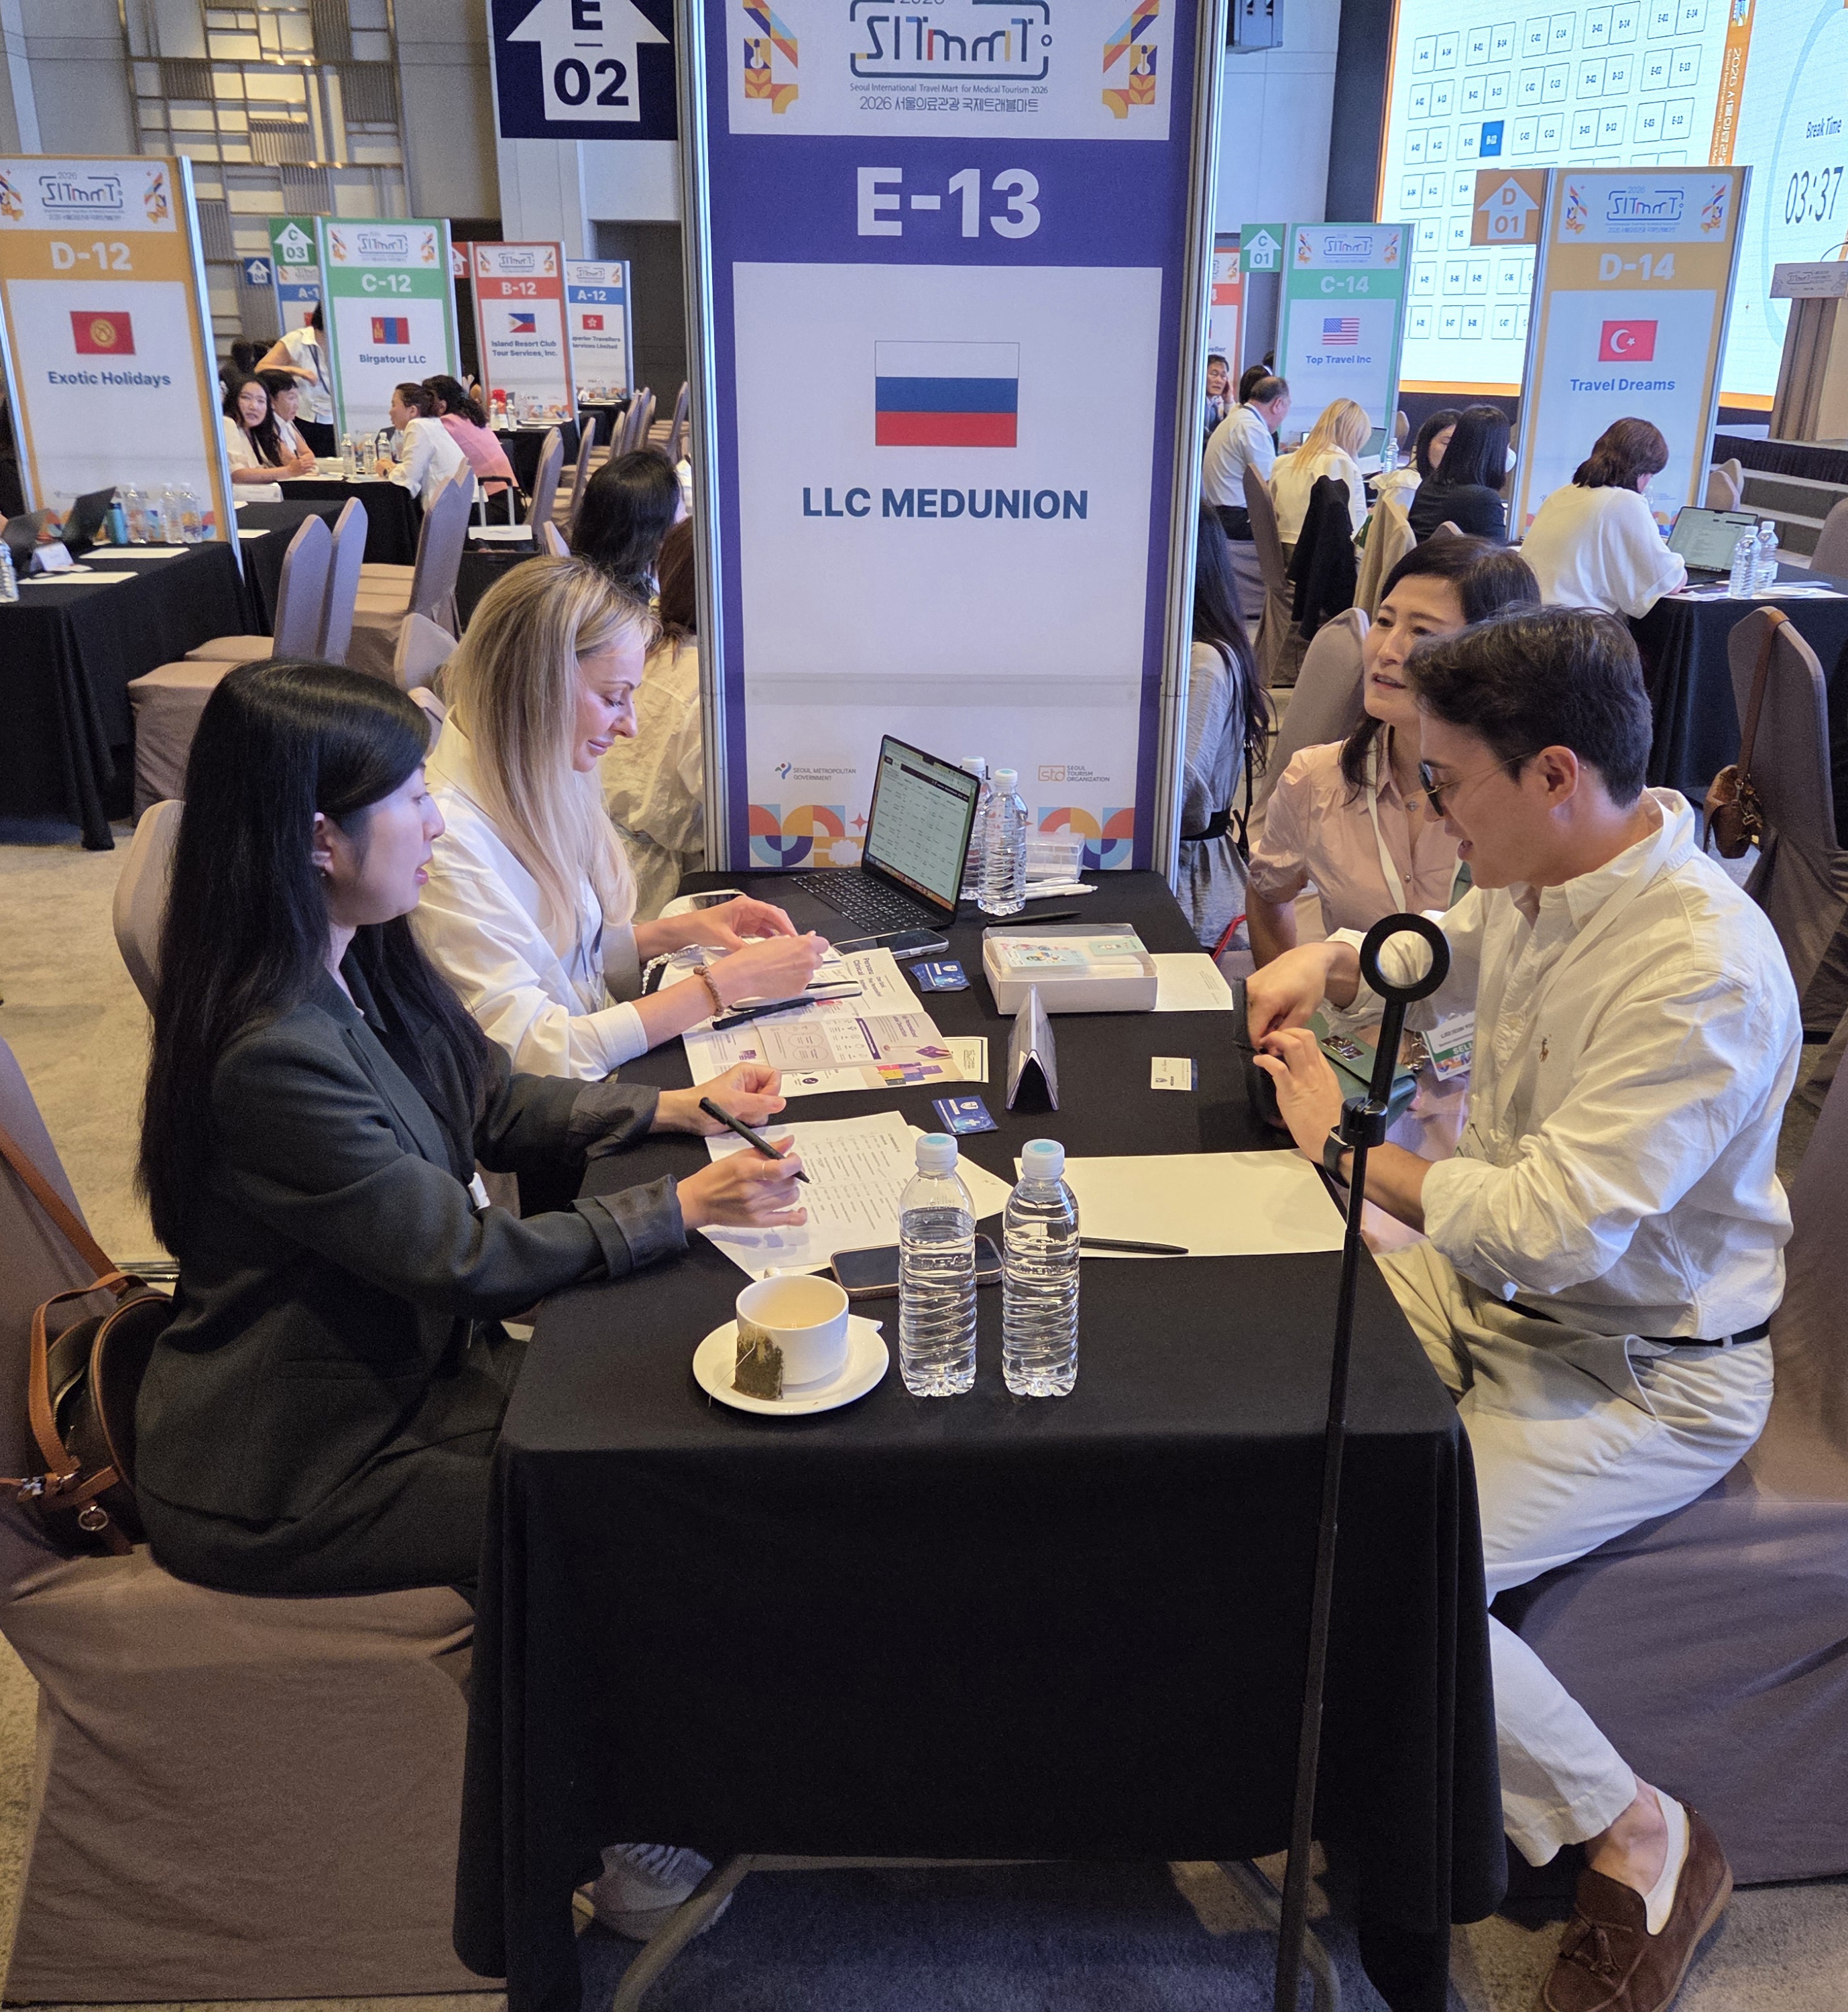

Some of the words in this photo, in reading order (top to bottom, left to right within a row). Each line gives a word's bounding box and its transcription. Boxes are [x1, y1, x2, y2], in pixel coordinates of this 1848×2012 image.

[571, 0, 602, 30] E
[554, 58, 628, 106] 02
[850, 83, 870, 91] Seoul
[872, 83, 916, 91] International
[919, 84, 939, 92] Travel
[962, 85, 971, 93] for
[1002, 85, 1029, 93] Tourism
[860, 96, 892, 109] 2026
[895, 97, 960, 111] 서울의료관광
[962, 98, 1038, 112] 국제트래블마트
[1806, 118, 1825, 138] Break
[1827, 116, 1841, 135] Time
[858, 167, 1040, 238] E-13
[1501, 188, 1517, 205] D
[1786, 166, 1844, 224] 03:37
[1495, 216, 1518, 233] 01
[288, 229, 299, 239] C
[1257, 235, 1268, 247] C
[50, 242, 133, 271] D-12
[286, 247, 306, 260] 03
[1254, 253, 1269, 264] 01
[1599, 253, 1675, 280] D-14
[362, 274, 412, 292] C-12
[502, 282, 536, 294] B-12
[1321, 276, 1369, 292] C-14
[577, 290, 606, 300] A-12
[359, 354, 406, 365] Birgatour
[408, 355, 426, 364] LLC
[1306, 356, 1323, 366] Top
[48, 371, 97, 384] Exotic
[101, 372, 171, 388] Holidays
[1570, 379, 1615, 390] Travel
[1619, 379, 1675, 390] Dreams
[803, 488, 870, 517] LLC
[882, 488, 1088, 519] MEDUNION
[813, 768, 856, 776] METROPOLITAN
